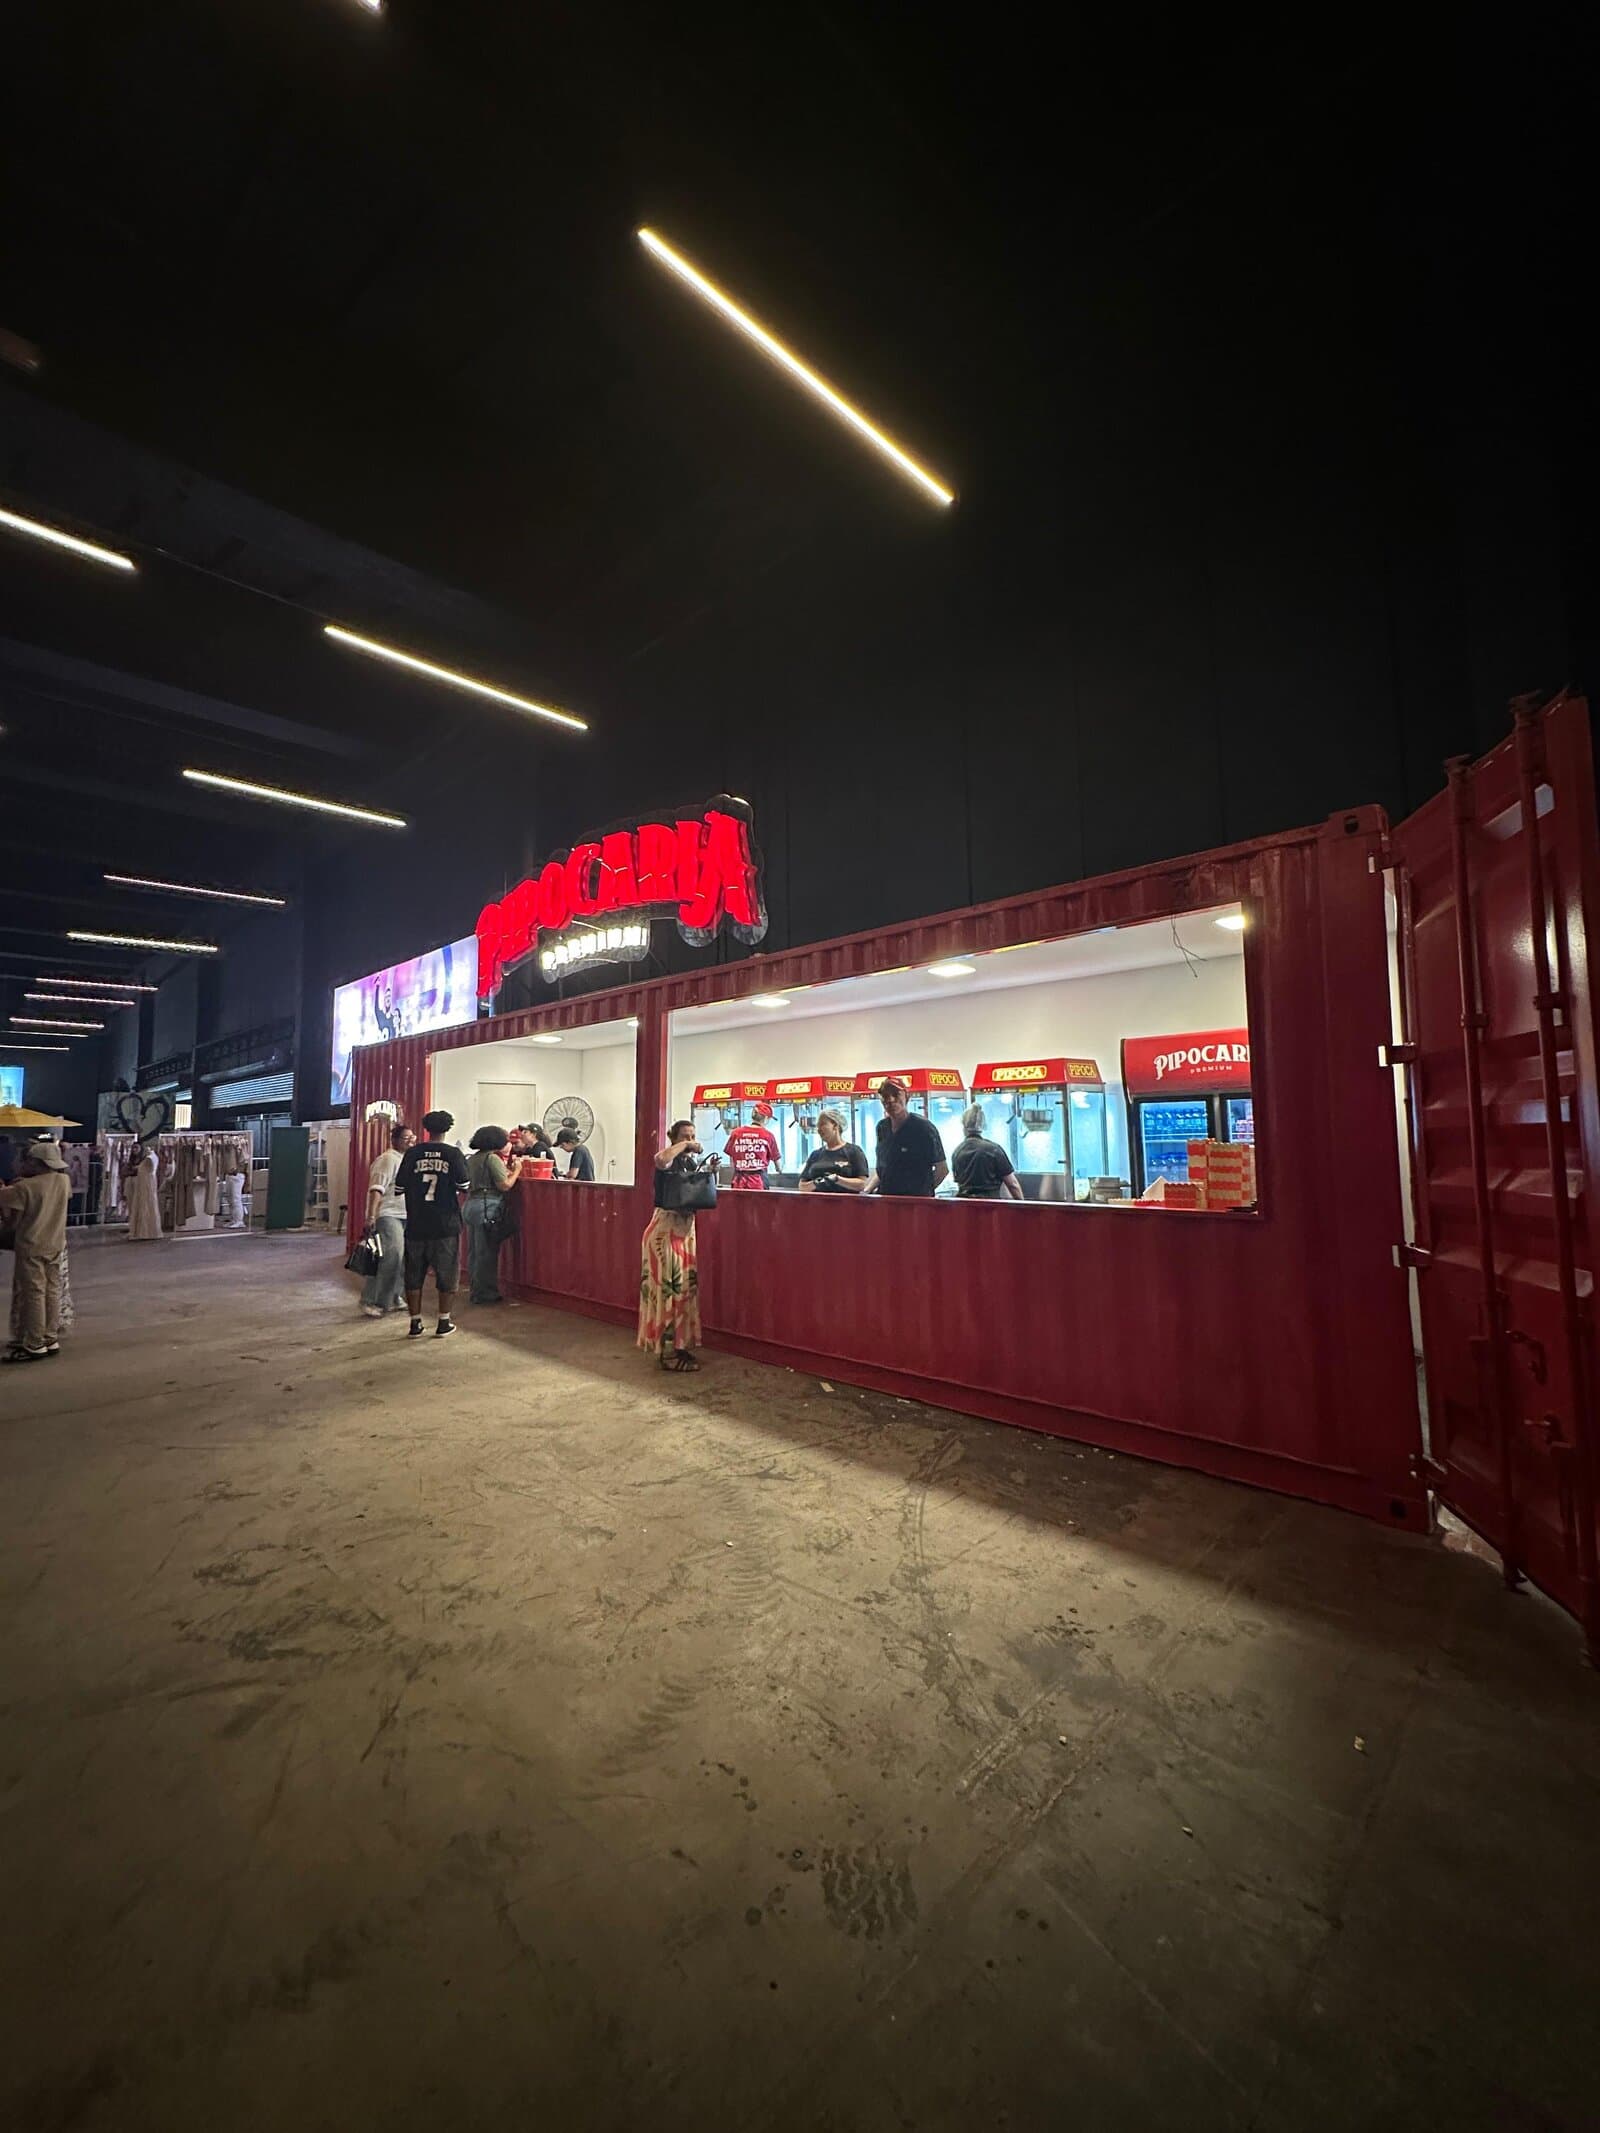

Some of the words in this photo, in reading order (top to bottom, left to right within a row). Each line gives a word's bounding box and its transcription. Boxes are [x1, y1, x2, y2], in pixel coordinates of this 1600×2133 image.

[1153, 1044, 1250, 1080] PIPOCAR
[996, 1067, 1043, 1080] PIPOCA
[1069, 1064, 1095, 1077] PIPOCA
[1189, 1065, 1233, 1074] PREMIUM
[931, 1073, 957, 1085] PIPOCA
[746, 1086, 764, 1096] PIPO
[735, 1145, 766, 1153] PIPOCA
[414, 1158, 449, 1174] JESUS
[736, 1159, 765, 1168] BRASIL
[422, 1173, 438, 1201] 7
